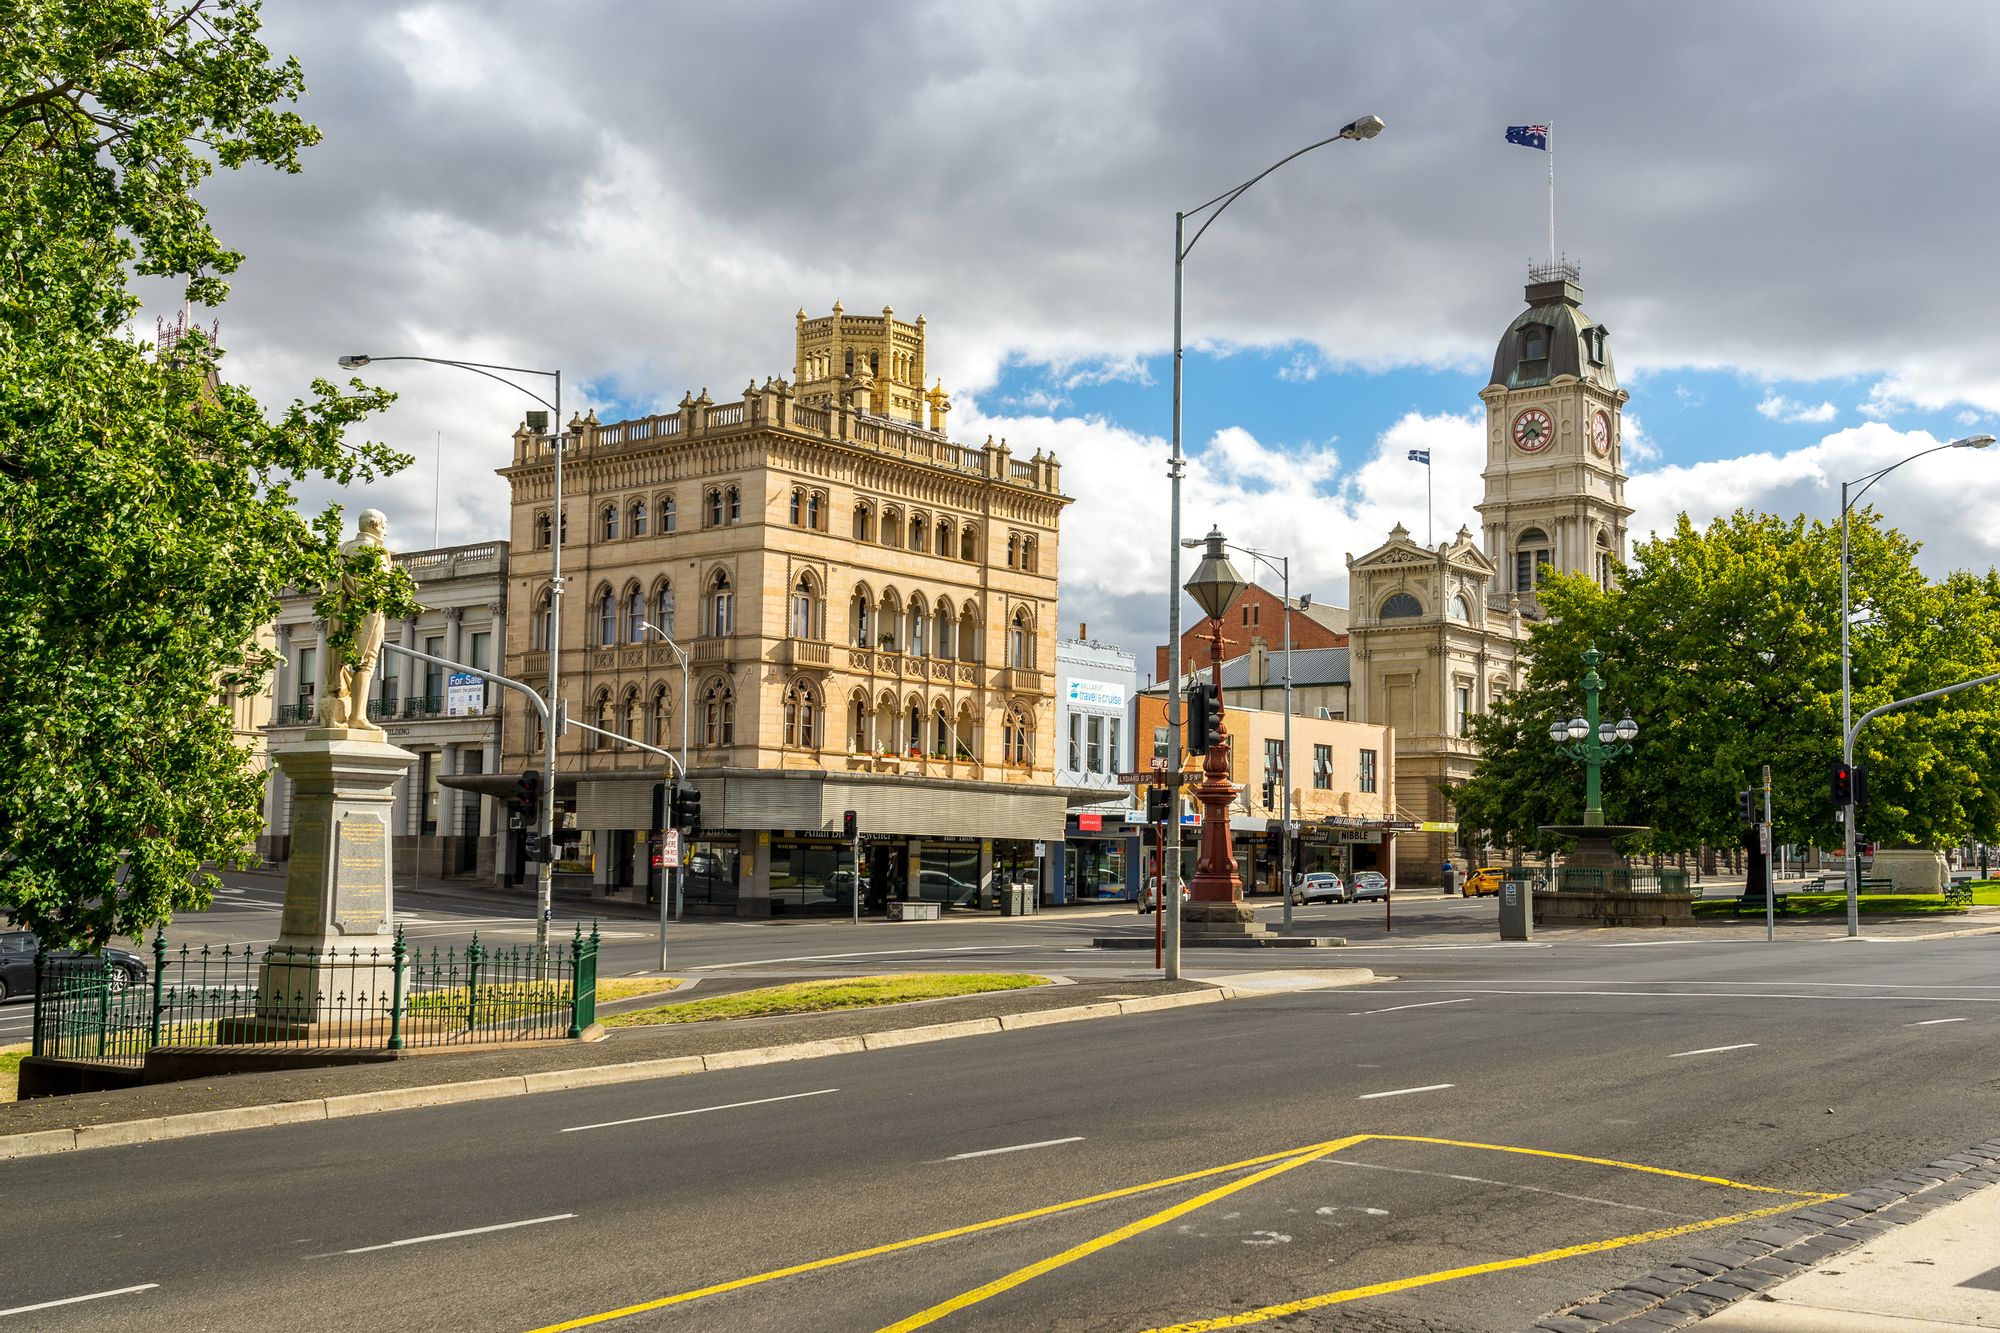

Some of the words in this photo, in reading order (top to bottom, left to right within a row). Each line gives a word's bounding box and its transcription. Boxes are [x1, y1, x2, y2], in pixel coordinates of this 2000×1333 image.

[450, 676, 463, 685] For
[465, 675, 482, 685] Sale
[1080, 691, 1097, 701] travel
[1102, 694, 1121, 705] cruise
[1120, 774, 1140, 783] LYDIARD
[1341, 831, 1368, 840] NIBBLE
